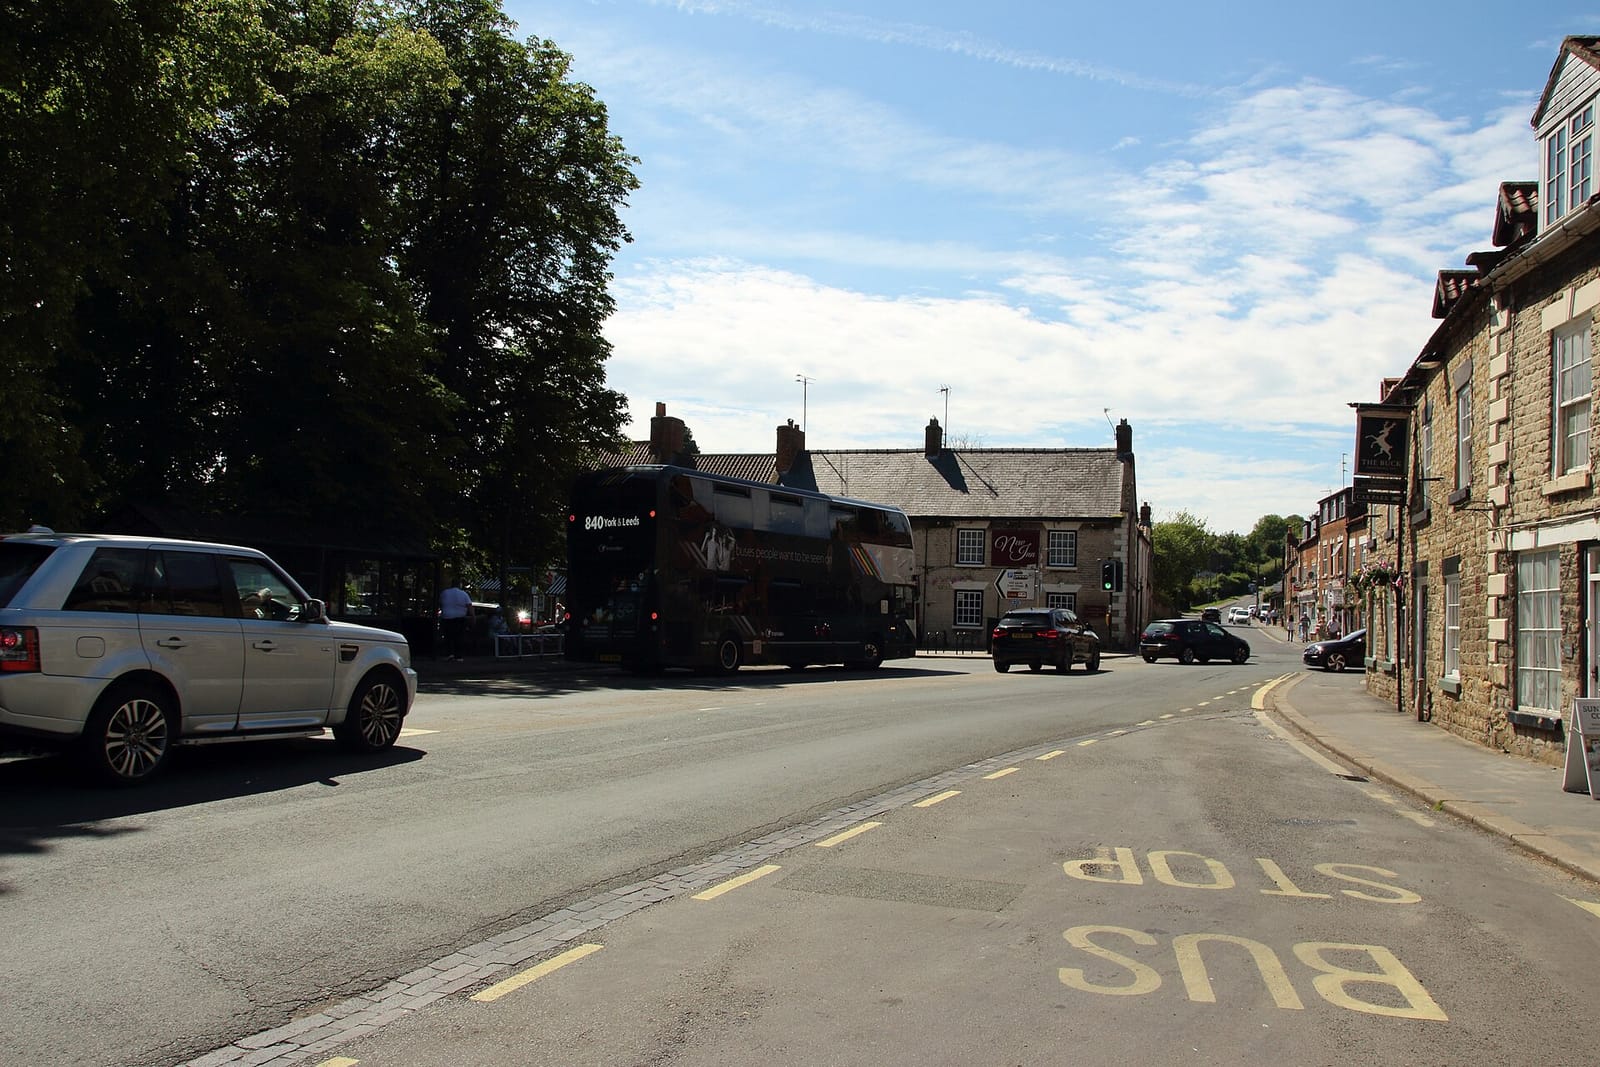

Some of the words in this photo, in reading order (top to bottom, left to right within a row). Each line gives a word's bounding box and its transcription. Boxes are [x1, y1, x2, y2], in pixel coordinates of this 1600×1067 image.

[1361, 458, 1377, 467] THE
[1379, 459, 1401, 467] BUCK
[584, 515, 604, 530] 840
[604, 516, 617, 528] York
[622, 515, 640, 527] Leeds
[994, 535, 1026, 552] New
[1009, 543, 1036, 561] Inn
[755, 546, 776, 561] people
[777, 550, 794, 561] want
[810, 553, 824, 565] seen
[1063, 847, 1422, 904] STOP
[1058, 925, 1449, 1021] BUS
